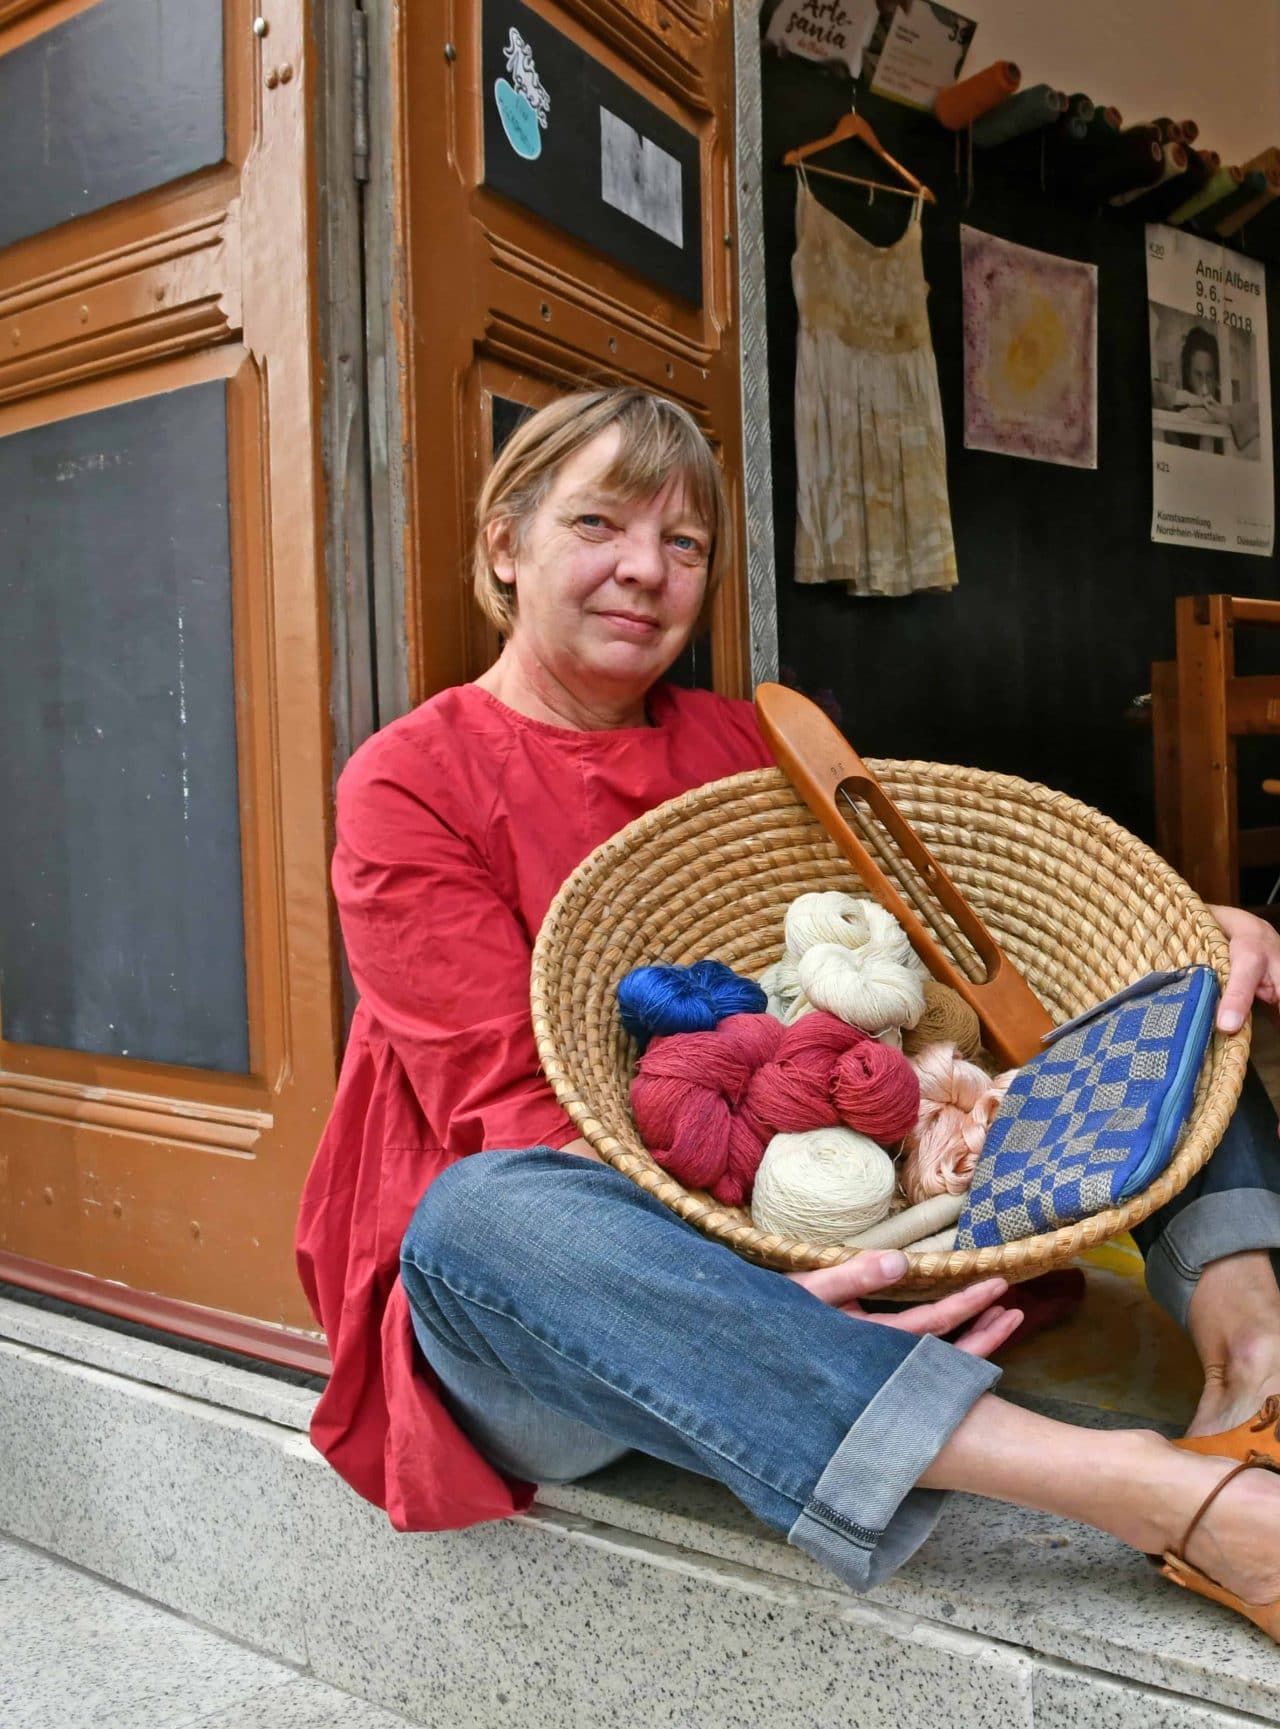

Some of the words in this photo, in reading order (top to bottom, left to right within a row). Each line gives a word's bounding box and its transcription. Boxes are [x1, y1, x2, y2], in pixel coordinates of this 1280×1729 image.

[1195, 259, 1223, 283] Anni
[1224, 269, 1261, 297] Albers
[1157, 511, 1211, 528] Kunstsammlung
